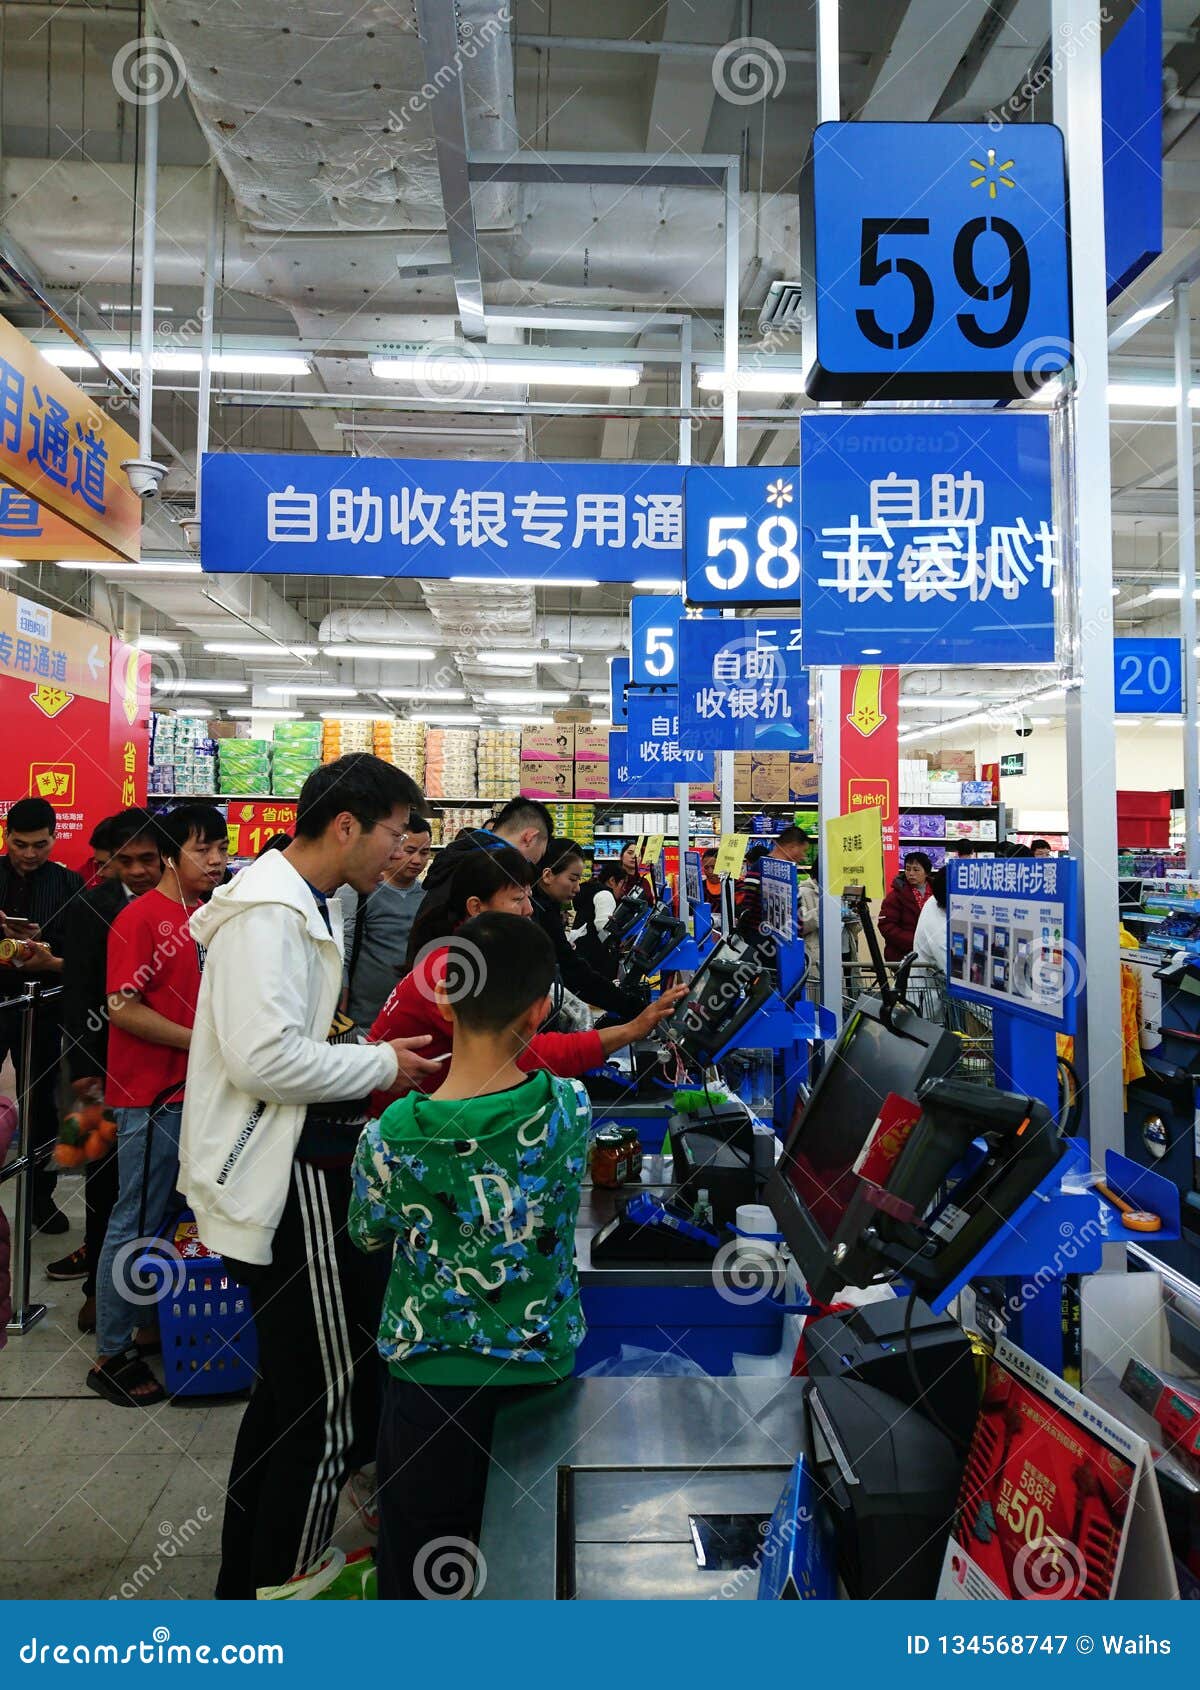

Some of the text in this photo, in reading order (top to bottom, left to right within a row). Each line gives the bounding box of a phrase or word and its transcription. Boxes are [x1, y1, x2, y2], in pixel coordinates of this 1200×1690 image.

[856, 216, 1030, 350] 59
[266, 486, 683, 549] 自助收银专用通
[870, 471, 985, 528] 自助
[704, 516, 800, 590] 58
[0, 632, 68, 682] 专用通道
[713, 650, 775, 680] 自助
[1119, 656, 1171, 695] 20
[696, 688, 791, 719] 收银机
[262, 807, 297, 822] 省心
[852, 793, 886, 806] 省心价
[958, 862, 1057, 895] 自助收银操作步骤
[1019, 1470, 1055, 1512] 588元
[1008, 1489, 1066, 1573] 50元
